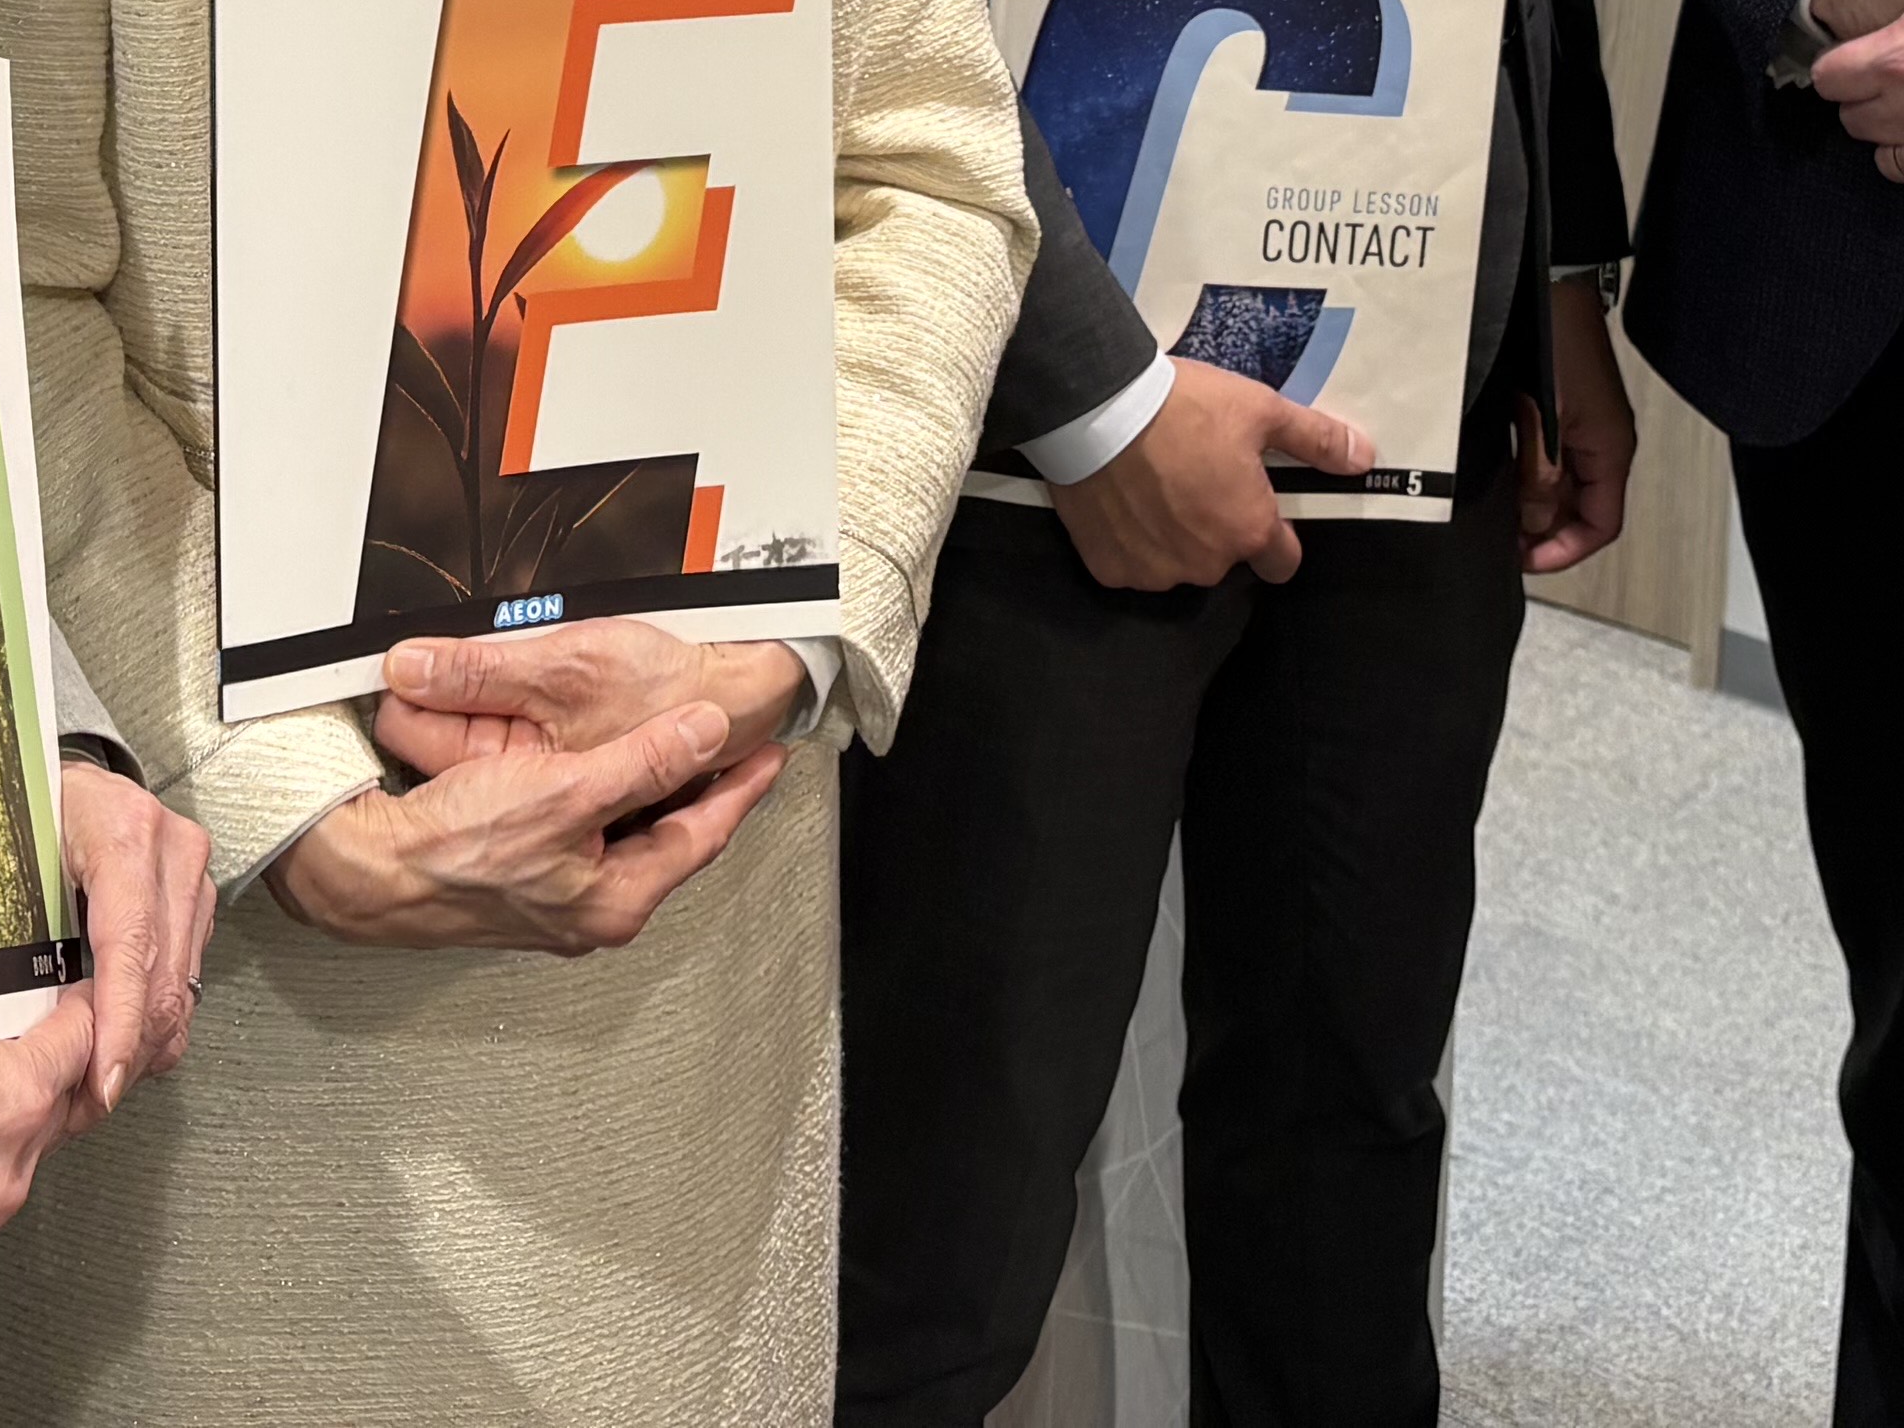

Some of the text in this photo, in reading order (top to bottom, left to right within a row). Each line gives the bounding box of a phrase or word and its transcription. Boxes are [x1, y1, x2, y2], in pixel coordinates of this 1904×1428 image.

[1266, 186, 1439, 217] GROUP LESSON
[1262, 218, 1436, 268] CONTACT
[1364, 470, 1423, 496] BOOK 5
[493, 593, 564, 629] AEON
[32, 955, 53, 977] BOOK
[55, 942, 67, 984] 5
